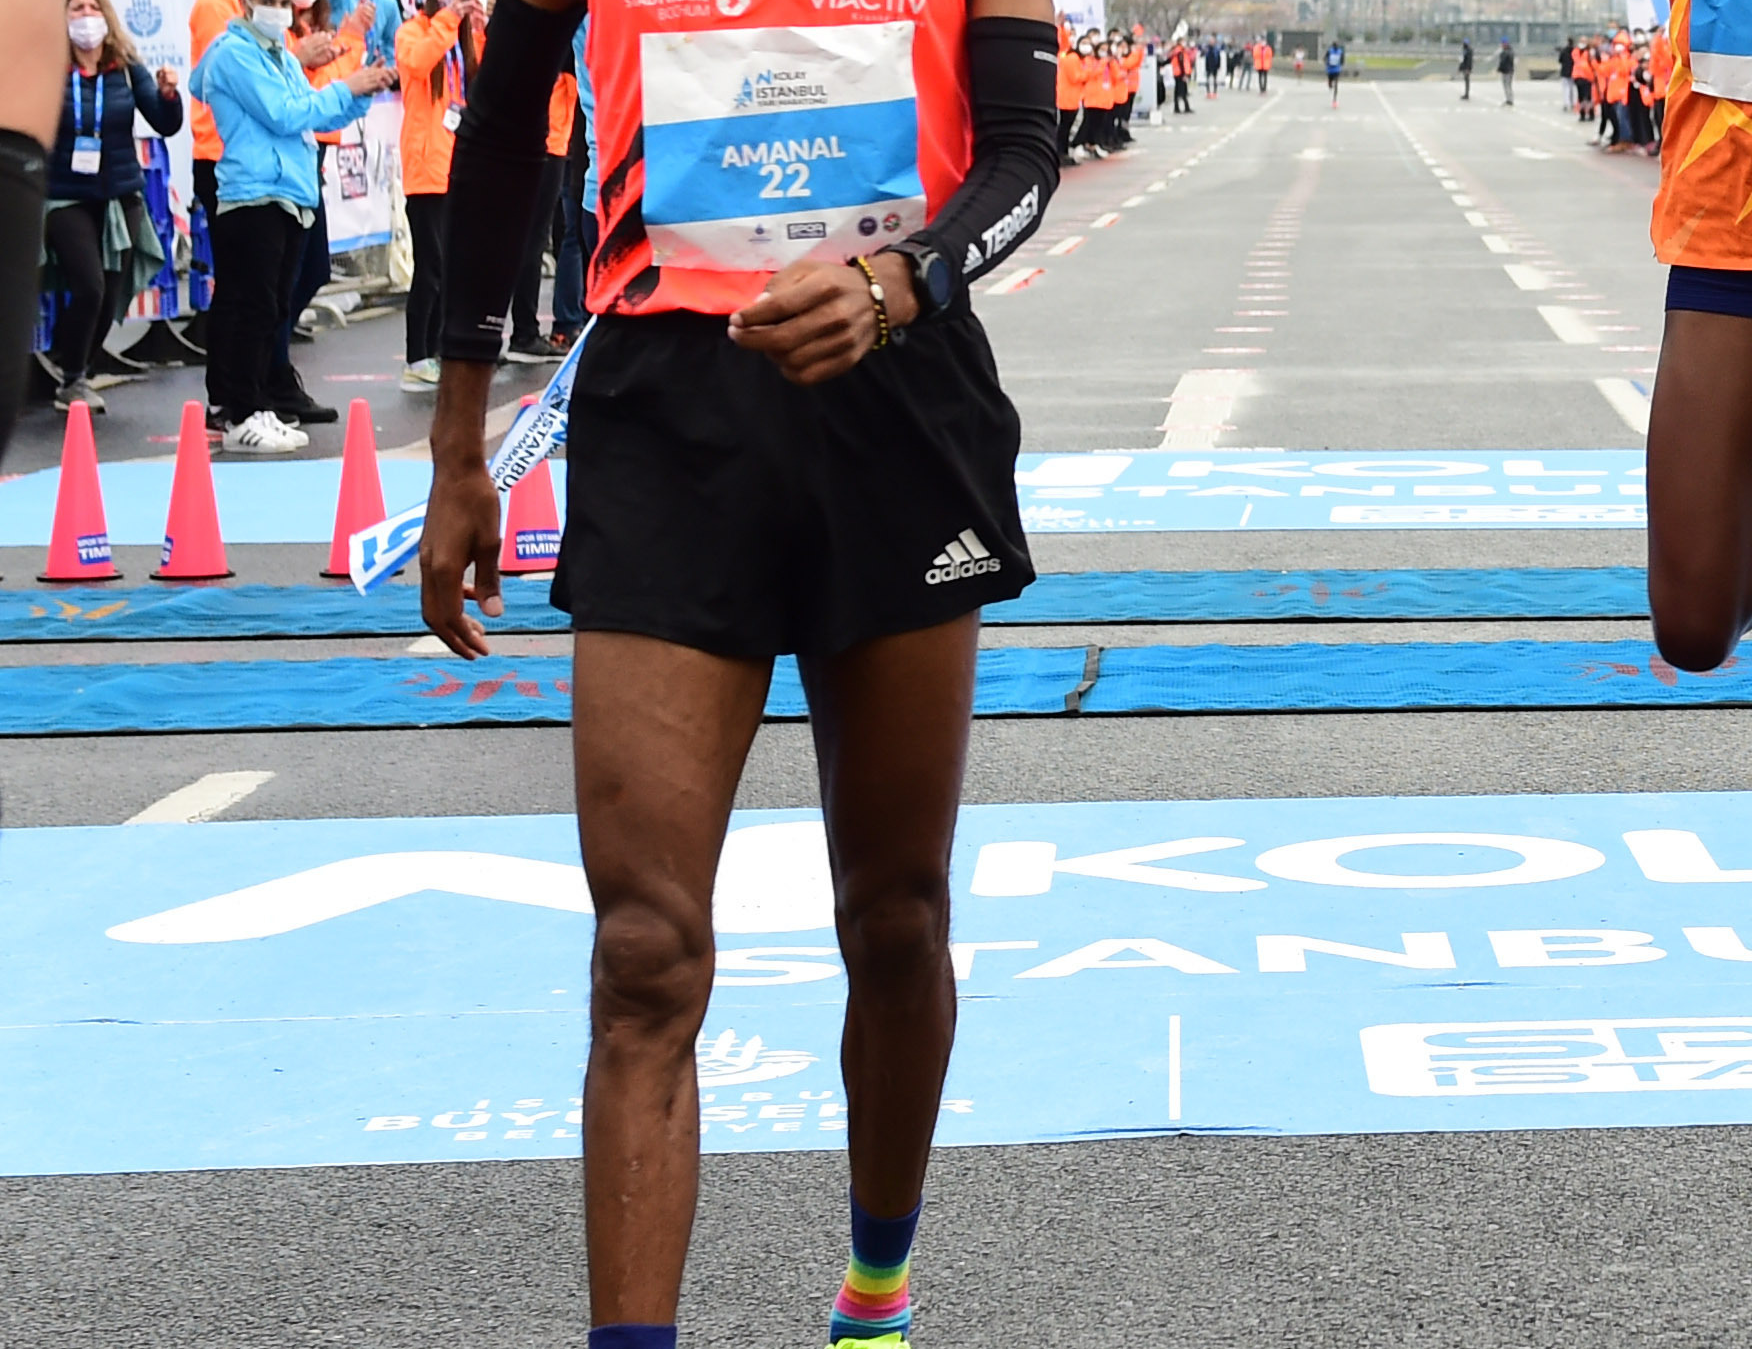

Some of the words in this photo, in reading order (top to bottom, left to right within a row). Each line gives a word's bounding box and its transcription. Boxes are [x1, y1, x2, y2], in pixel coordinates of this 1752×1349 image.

[721, 136, 846, 168] AMANAL
[759, 162, 811, 199] 22
[925, 557, 1001, 585] adidas
